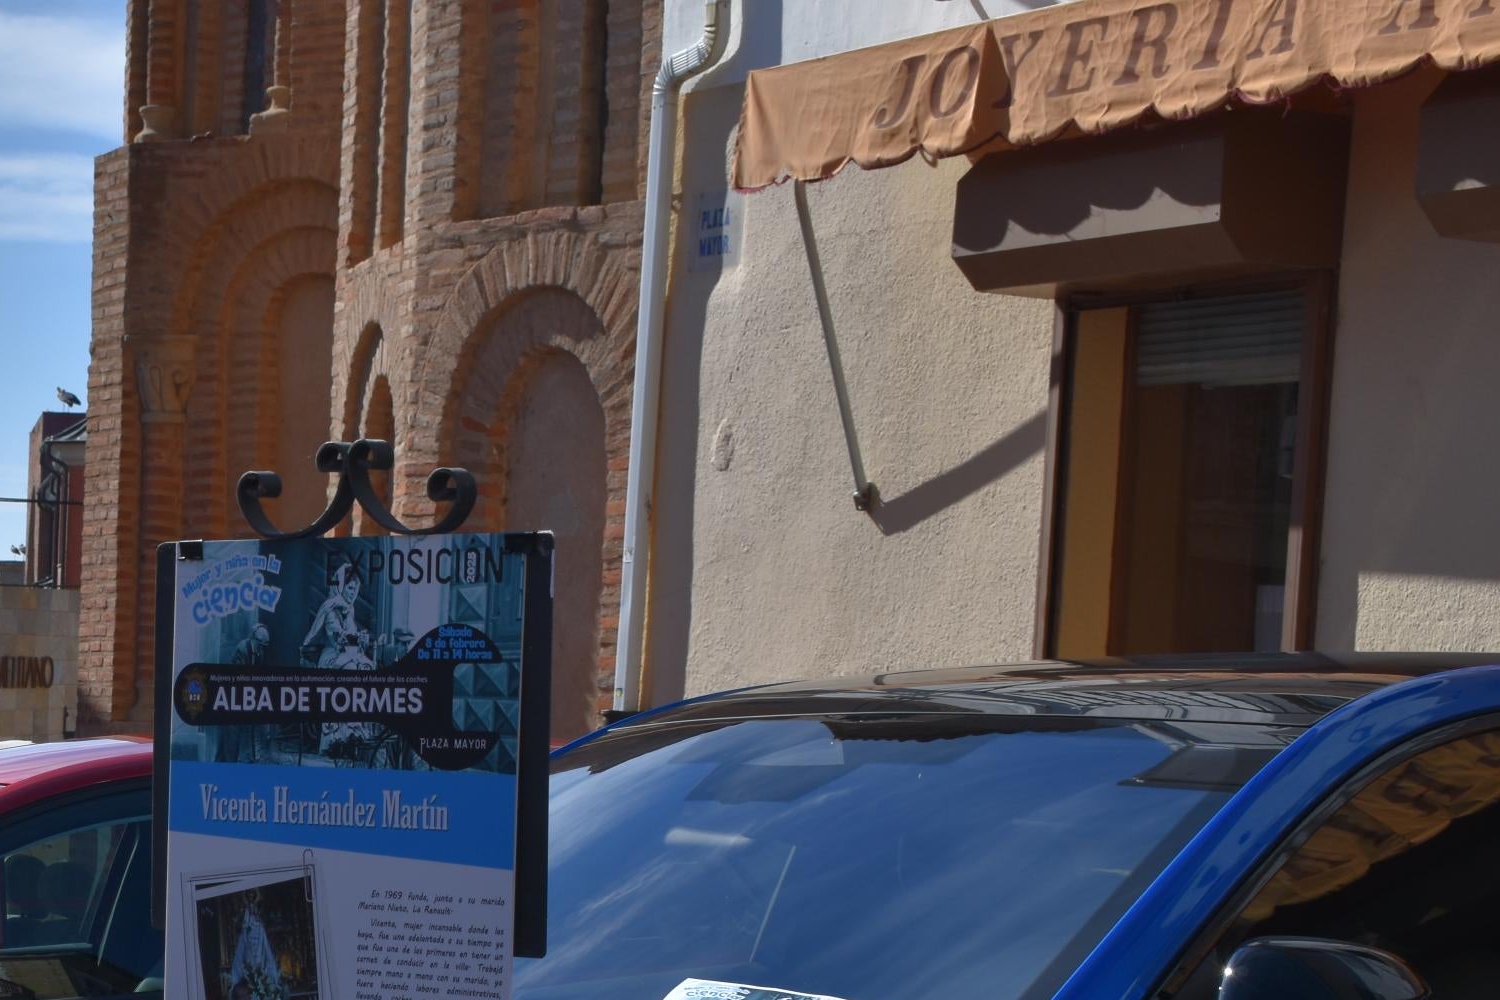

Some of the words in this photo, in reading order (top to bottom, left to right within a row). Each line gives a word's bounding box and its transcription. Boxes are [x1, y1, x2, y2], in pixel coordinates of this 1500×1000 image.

[701, 207, 731, 230] PLAZA
[268, 554, 280, 571] la
[467, 551, 476, 583] 2025
[212, 685, 274, 712] ALBA
[280, 686, 310, 712] DE
[315, 686, 424, 714] TORMES
[419, 737, 450, 754] PLAZA
[454, 737, 487, 750] MAYOR
[200, 783, 267, 824] Vicenta
[273, 784, 377, 829] Hernández
[381, 789, 449, 831] Martín
[358, 902, 384, 911] Mariano
[385, 891, 402, 899] 1969
[481, 897, 504, 906] marido
